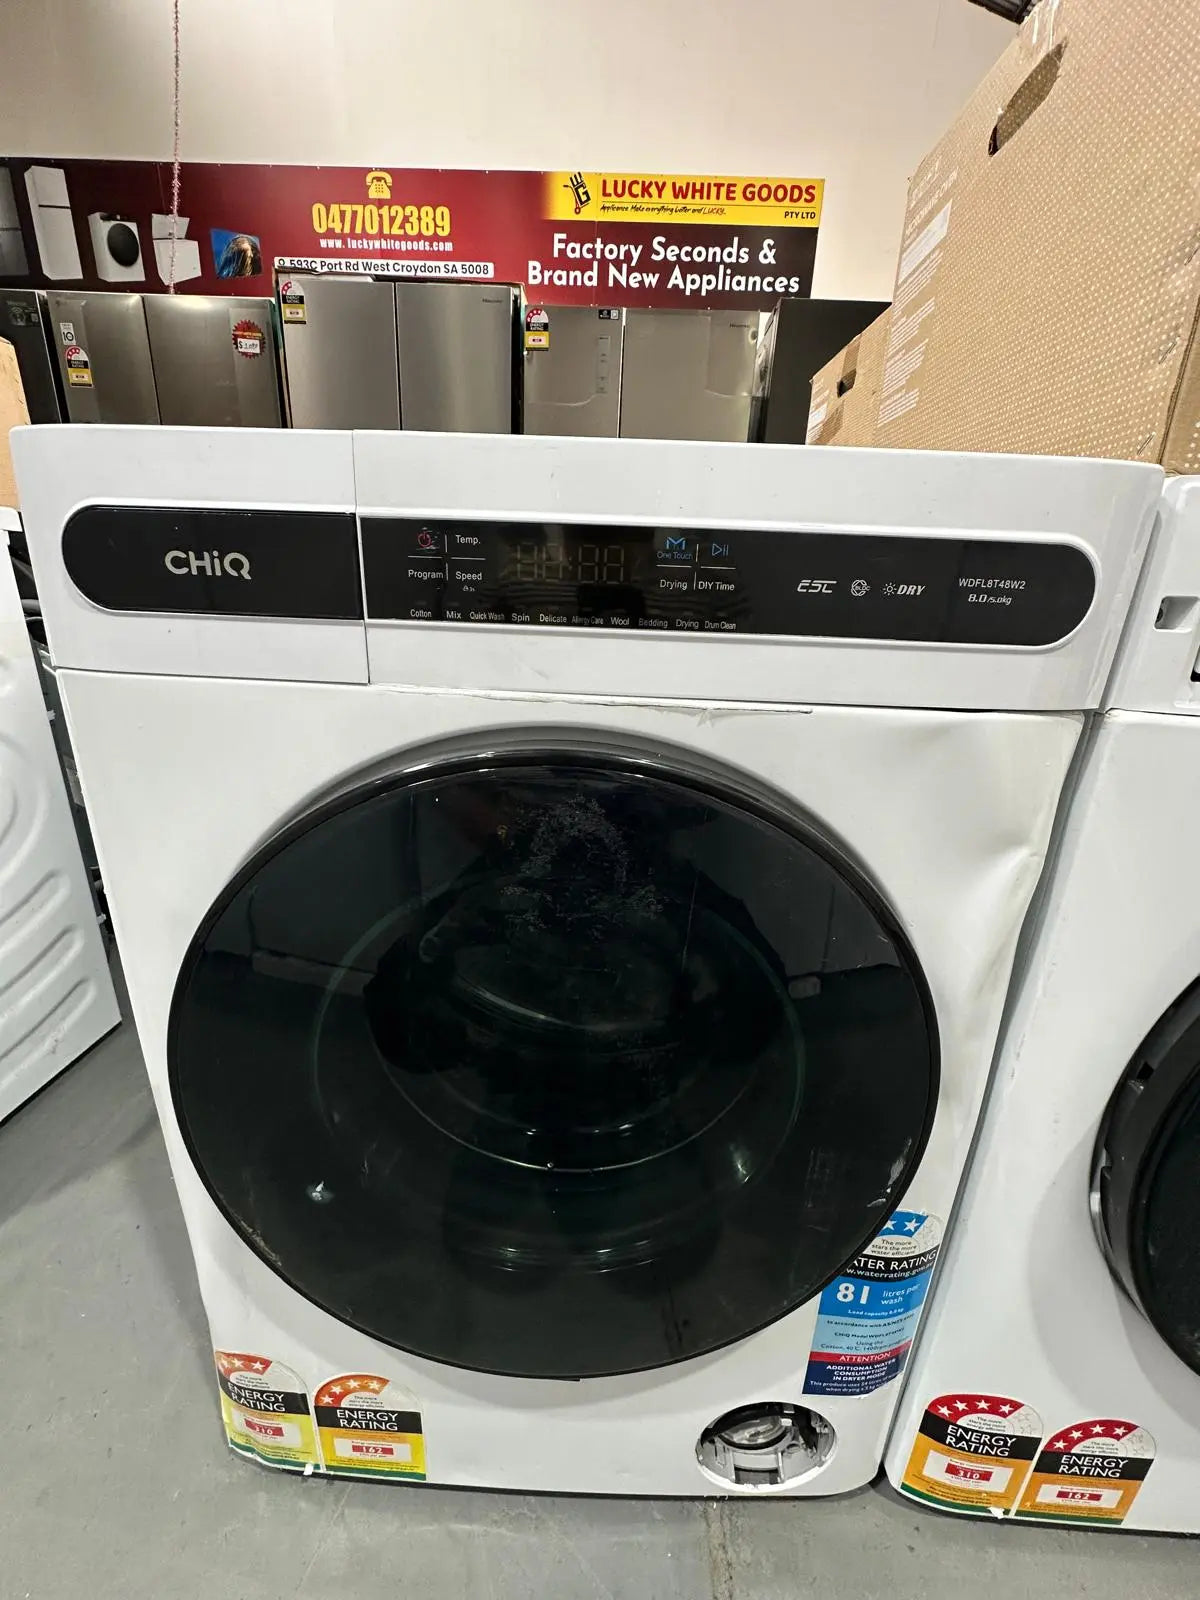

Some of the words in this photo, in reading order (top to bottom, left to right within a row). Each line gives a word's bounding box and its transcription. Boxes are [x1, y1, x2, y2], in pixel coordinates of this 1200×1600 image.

[602, 179, 666, 198] LUCKY
[672, 182, 737, 200] WHITE
[742, 183, 816, 203] GOODS
[312, 203, 450, 236] 0477012389
[553, 233, 643, 266] Factory
[651, 236, 749, 263] Seconds
[758, 239, 776, 264] &
[320, 260, 342, 270] Port
[345, 260, 359, 271] Rd
[362, 262, 390, 272] West
[392, 262, 440, 276] Croydon
[444, 264, 458, 274] SA
[461, 264, 488, 274] 5008
[528, 260, 598, 287] Brand
[608, 263, 660, 289] New
[667, 265, 800, 296] Appliances
[456, 534, 480, 546] Temp.
[673, 552, 693, 560] Touch
[164, 550, 252, 580] CHiQ
[408, 570, 444, 580] Program
[456, 571, 482, 582] Speed
[660, 580, 688, 590] Drying
[698, 581, 714, 590] DIY
[714, 582, 735, 591] Time
[959, 578, 1026, 589] WDFL8T48W2
[896, 584, 926, 596] DRY
[410, 609, 432, 618] Cotton
[446, 610, 462, 619] Mix
[470, 612, 487, 620] Quick
[488, 612, 505, 621] Wash
[512, 613, 530, 623] Spin
[540, 614, 567, 623] Delicate
[571, 616, 590, 626] Allergy
[590, 616, 604, 625] Care
[610, 617, 630, 626] Wool
[638, 618, 668, 628] Bedding
[676, 619, 699, 629] Drying
[704, 620, 720, 629] Drum
[720, 621, 736, 630] Clean
[853, 1257, 885, 1270] ATER
[890, 1250, 936, 1270] RATING
[881, 1296, 903, 1304] wash
[839, 1352, 891, 1362] ATTENTION
[874, 1358, 896, 1368] WATER
[834, 1366, 888, 1376] CONSUMPTION
[228, 1382, 284, 1402] ENERGY
[232, 1393, 286, 1412] RATING
[336, 1409, 398, 1422] ENERGY
[340, 1419, 398, 1431] RATING
[947, 1425, 1017, 1448] ENERGY
[363, 1446, 384, 1454] 162
[945, 1436, 1010, 1456] RATING
[1061, 1454, 1128, 1468] ENERGY
[958, 1470, 980, 1479] 310
[1058, 1465, 1122, 1478] RATING
[1068, 1492, 1090, 1500] 162
